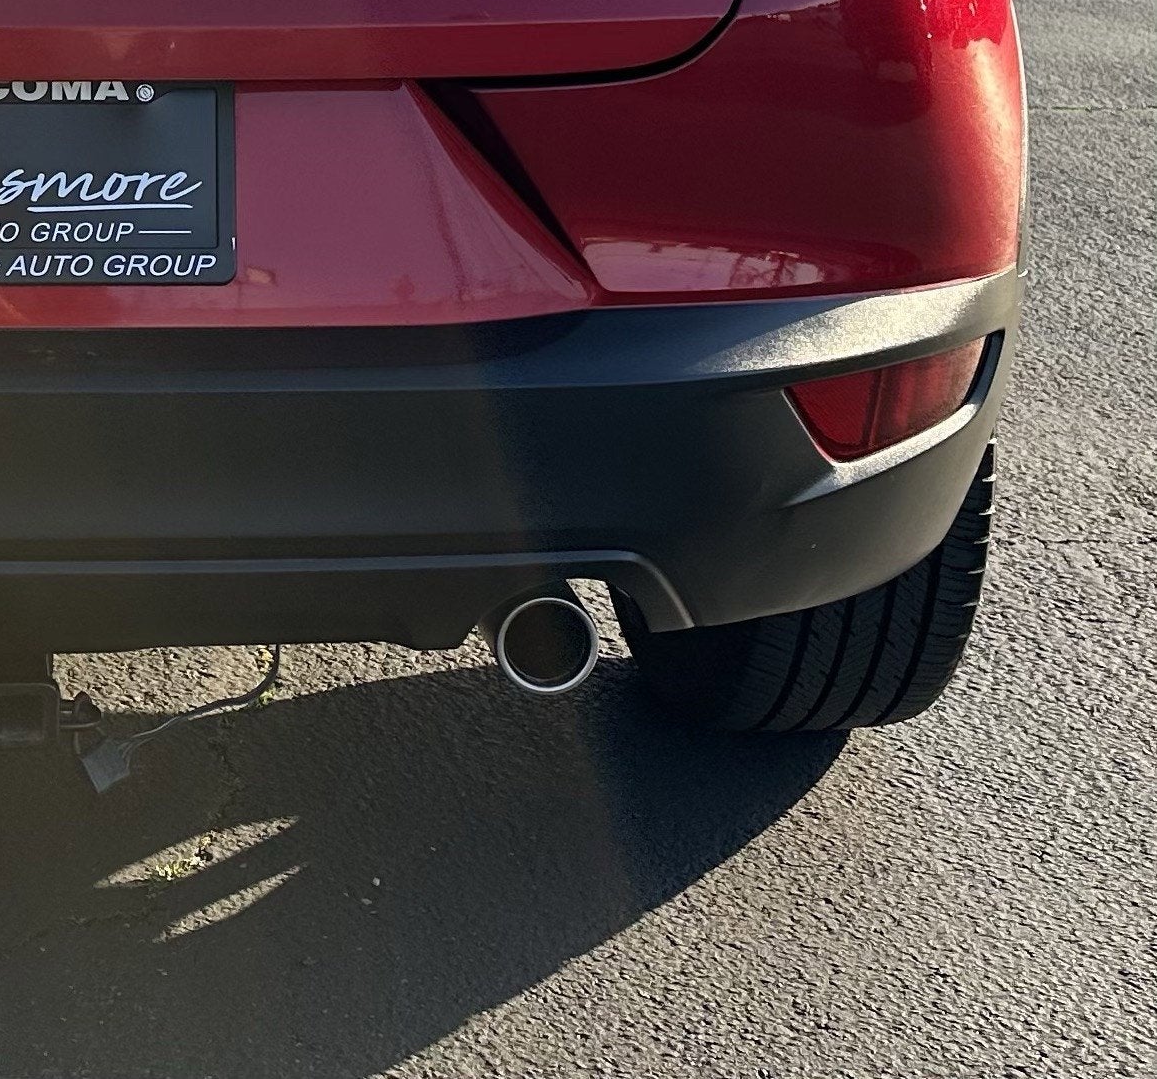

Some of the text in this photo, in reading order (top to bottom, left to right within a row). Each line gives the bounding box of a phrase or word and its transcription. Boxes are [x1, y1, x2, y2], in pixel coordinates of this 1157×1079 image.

[30, 222, 134, 242] GROUP
[6, 255, 92, 277] AUTO
[103, 254, 217, 277] GROUP
